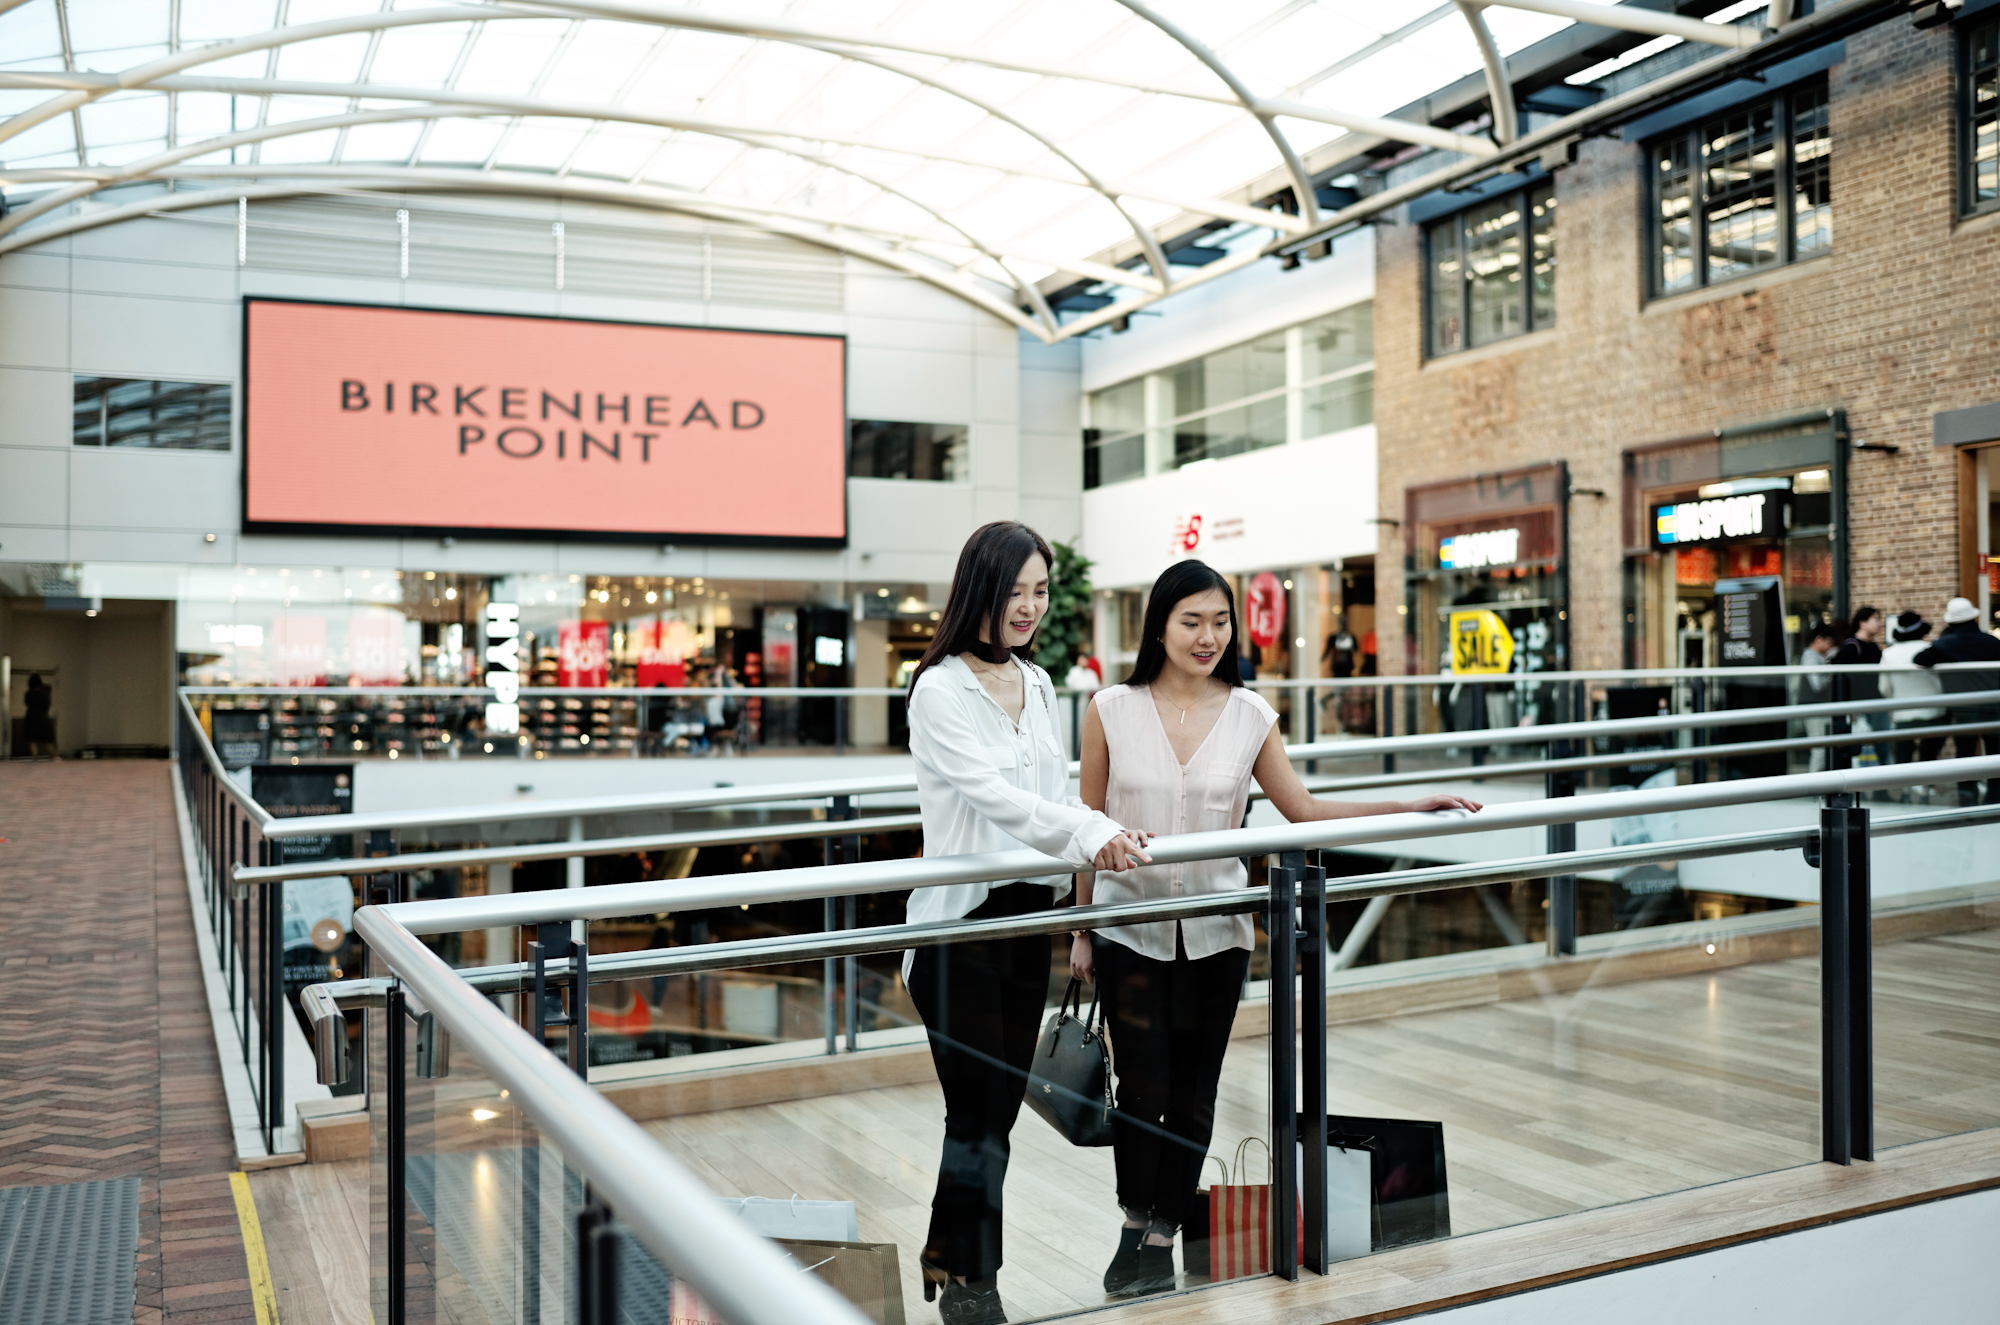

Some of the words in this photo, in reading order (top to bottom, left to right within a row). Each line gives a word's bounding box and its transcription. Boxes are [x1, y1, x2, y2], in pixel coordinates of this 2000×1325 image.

[341, 379, 766, 430] BIRKENHEAD
[457, 424, 661, 464] POINT
[486, 602, 519, 734] HYPE
[1458, 633, 1502, 670] SALE
